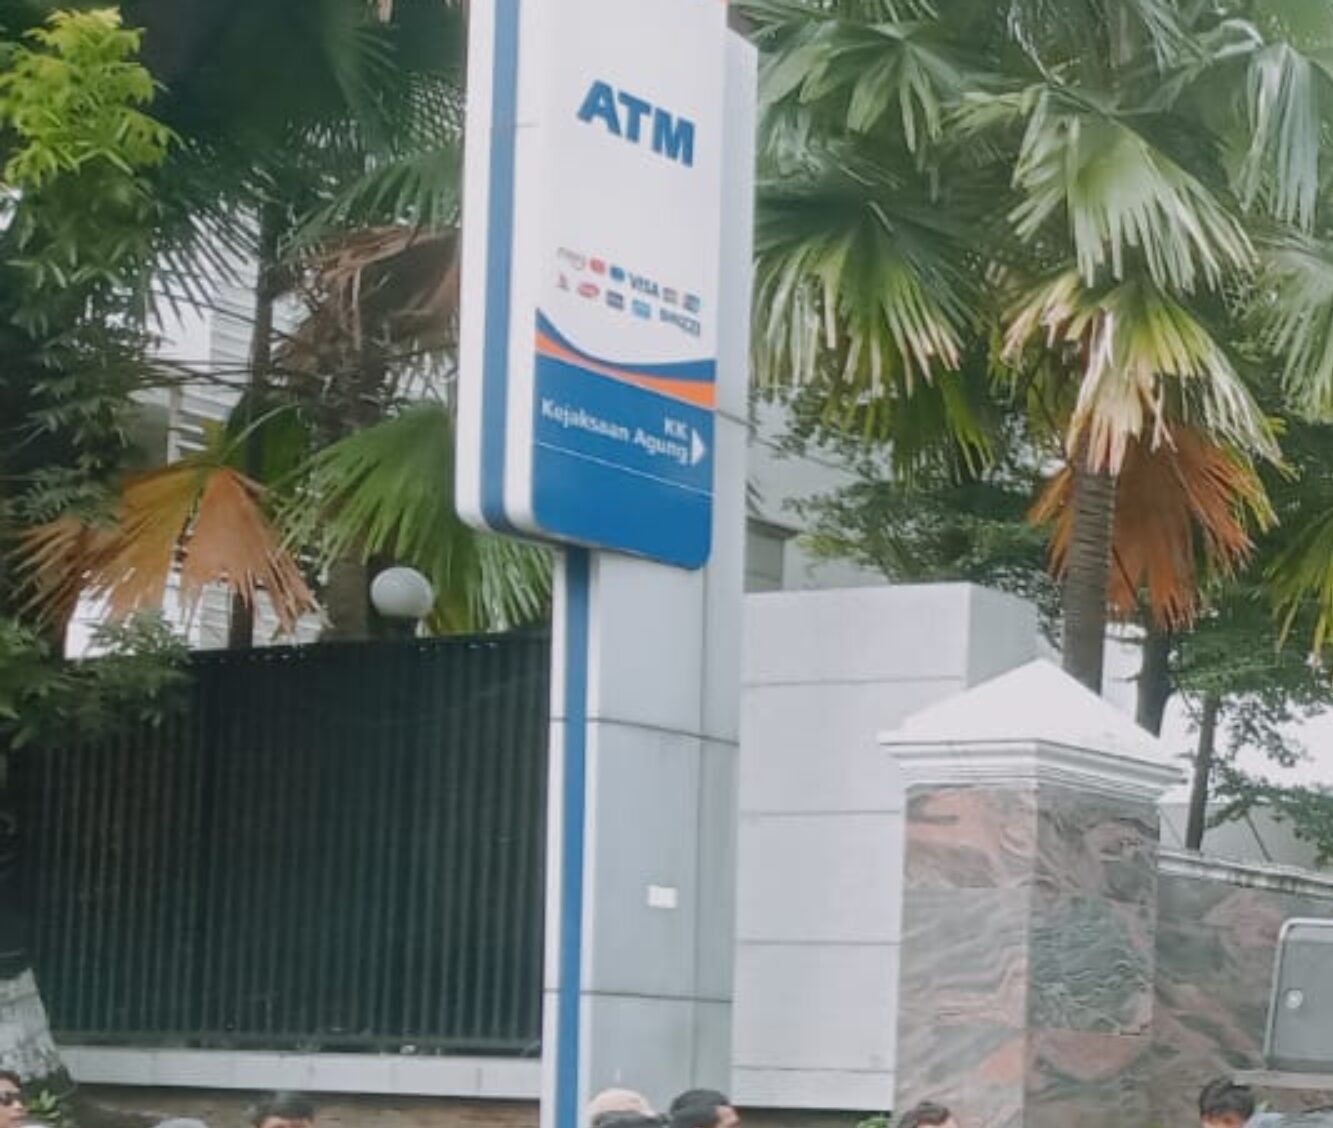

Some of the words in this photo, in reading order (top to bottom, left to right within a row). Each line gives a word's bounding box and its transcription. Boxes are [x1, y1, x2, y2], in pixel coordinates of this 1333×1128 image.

[576, 79, 695, 168] ATM
[629, 271, 660, 299] VISA
[541, 396, 630, 442] Kejaksaan
[633, 425, 689, 467] Agung
[664, 415, 689, 440] KK
